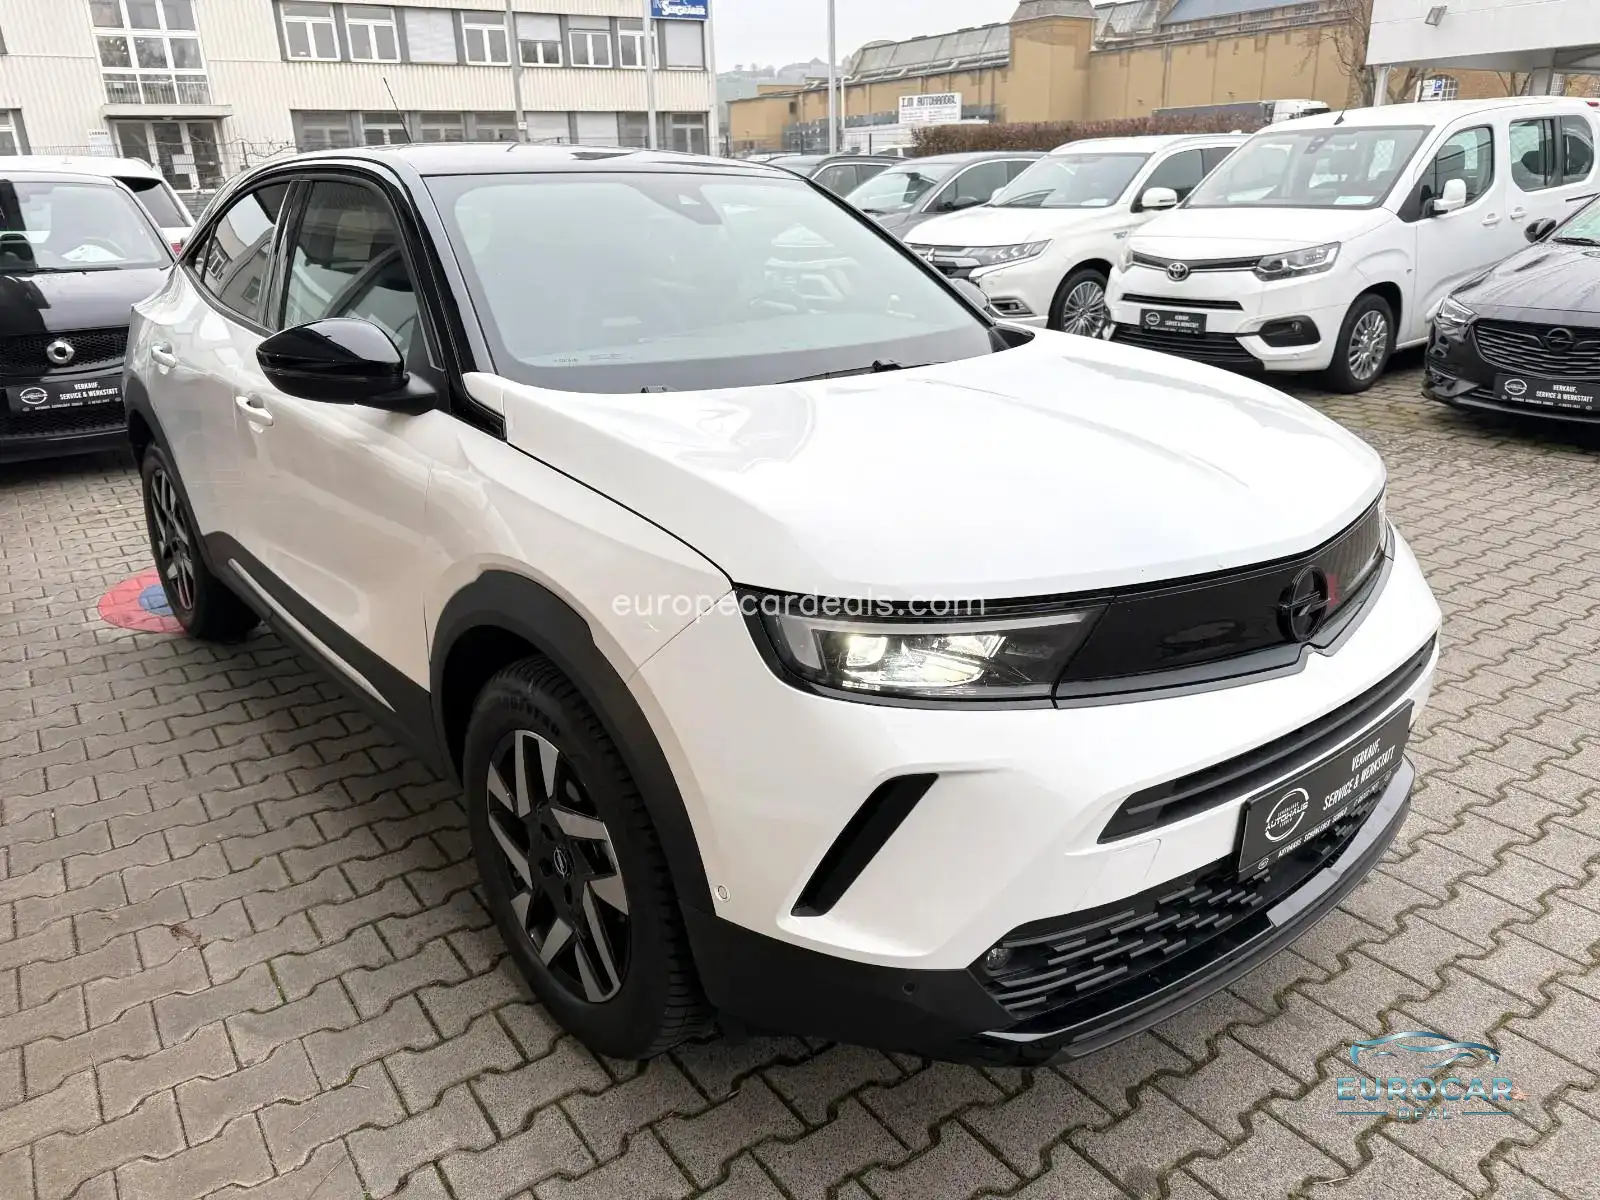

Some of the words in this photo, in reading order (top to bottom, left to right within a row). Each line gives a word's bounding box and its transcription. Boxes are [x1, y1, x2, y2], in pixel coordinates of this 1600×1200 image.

[60, 392, 82, 400] SERVICE
[88, 387, 118, 397] WERKSTATT
[1535, 390, 1556, 399] SERVICE
[1562, 393, 1594, 402] WERKSTATT
[1322, 780, 1353, 811] SERVICE
[1353, 774, 1360, 788] &
[1360, 744, 1396, 783] WERKSTATT
[1265, 801, 1309, 831] AUTOHAUS
